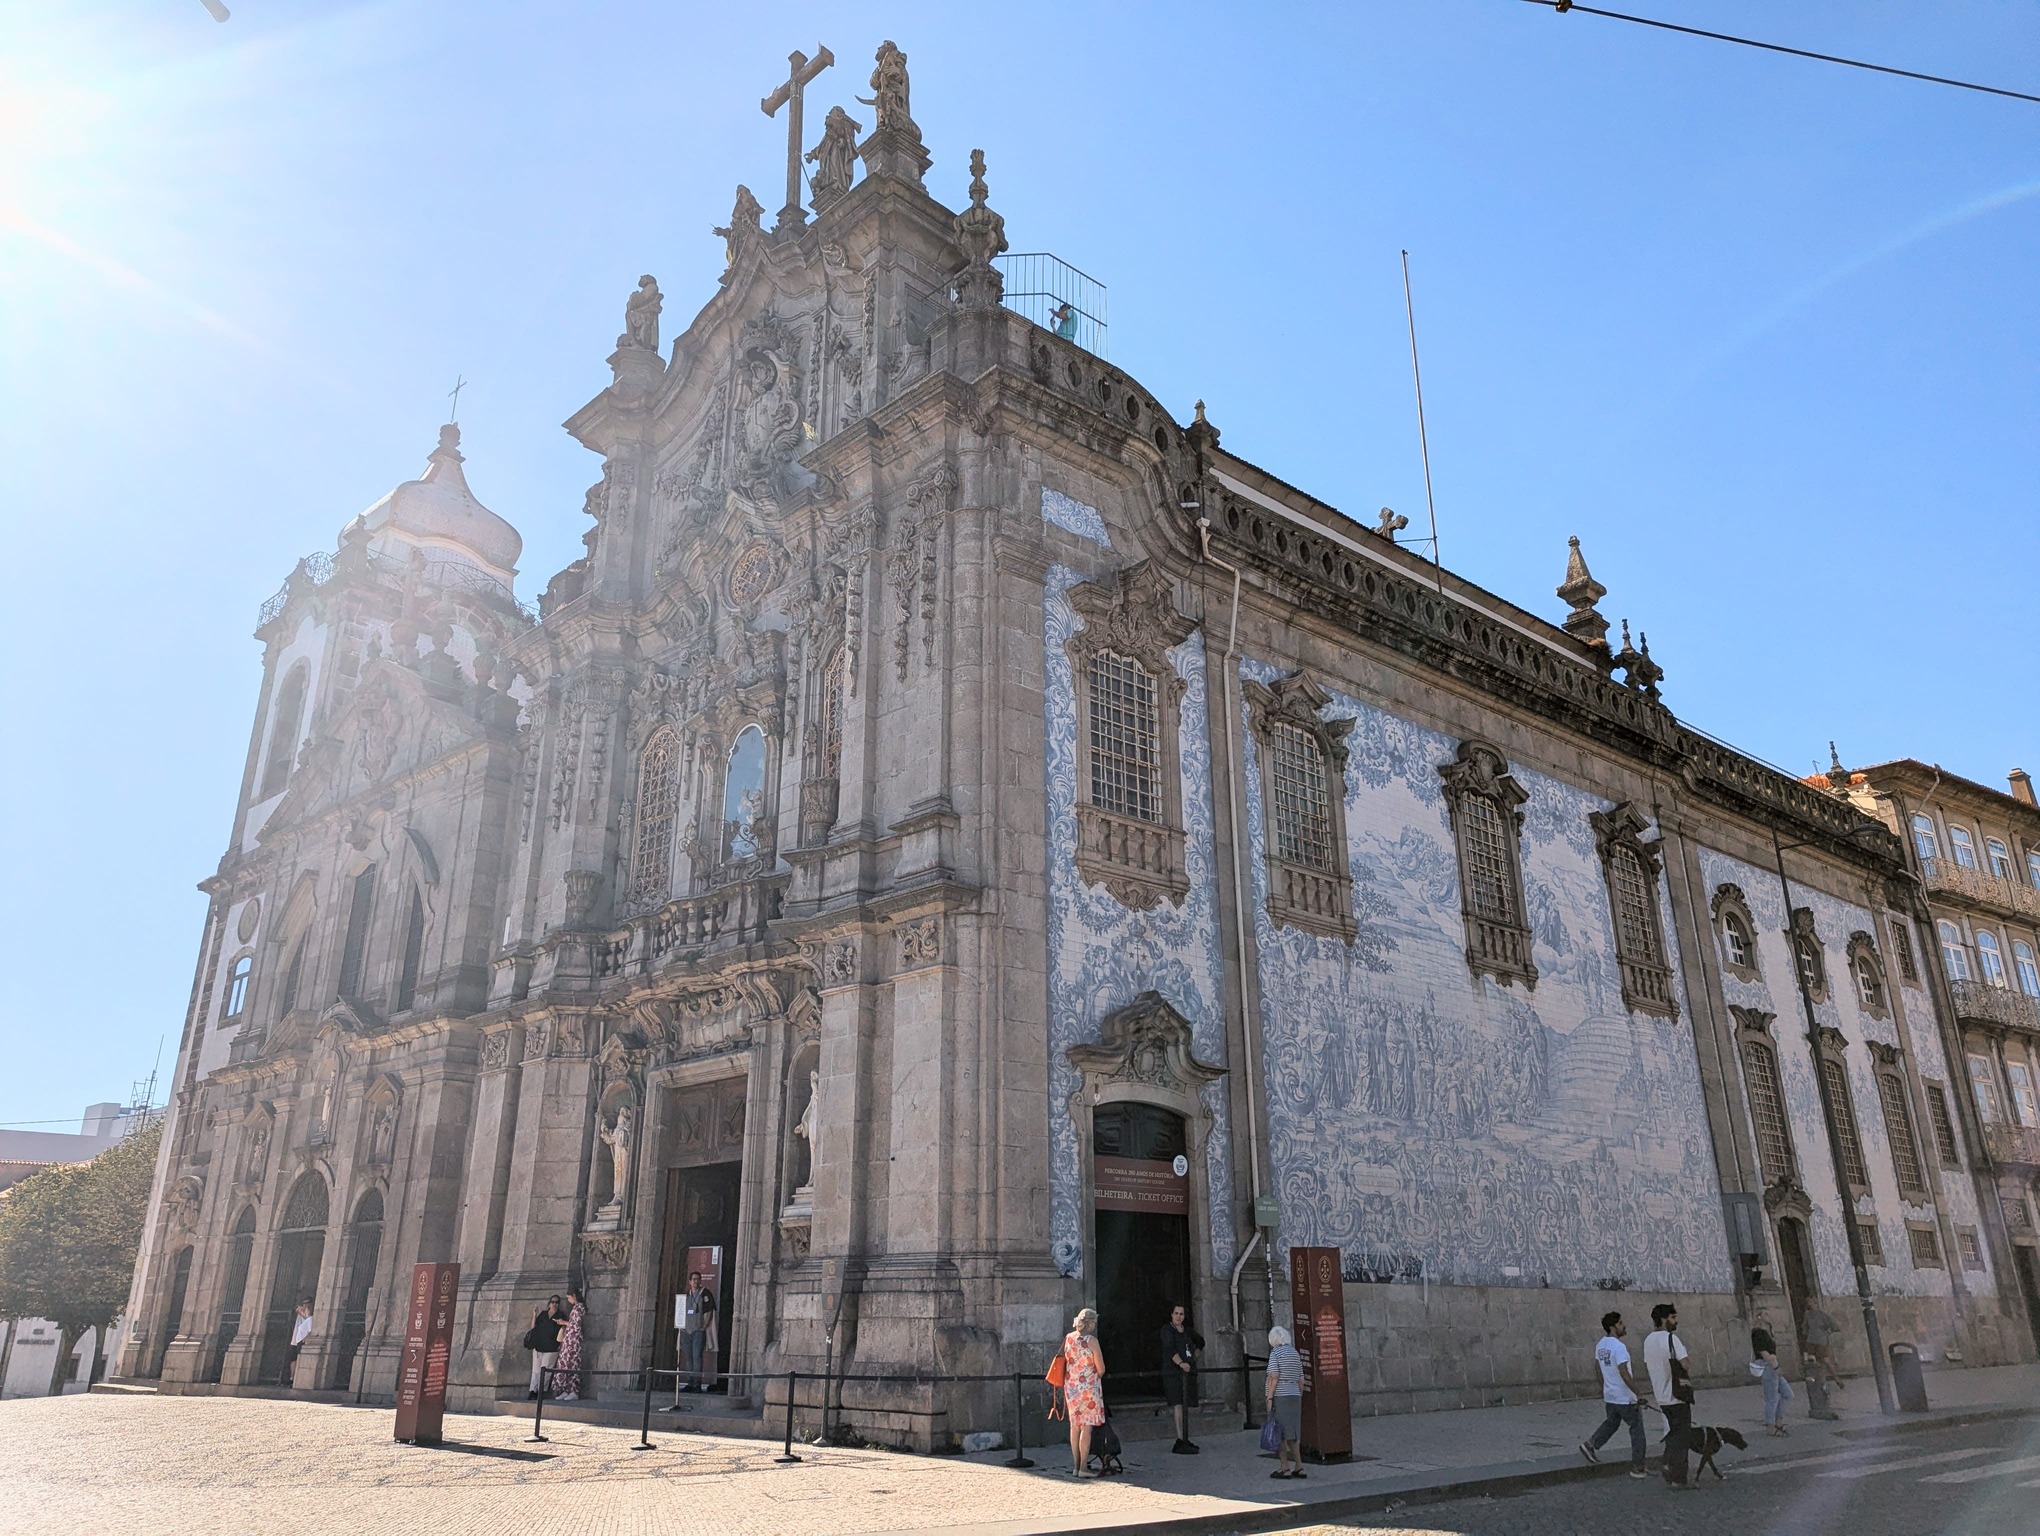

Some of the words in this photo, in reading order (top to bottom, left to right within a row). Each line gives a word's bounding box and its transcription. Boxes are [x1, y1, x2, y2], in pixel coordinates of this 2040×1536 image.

[1094, 1189, 1133, 1199] BILHETEIRA
[1138, 1193, 1160, 1201] TICKET
[1161, 1194, 1184, 1203] OFFICE
